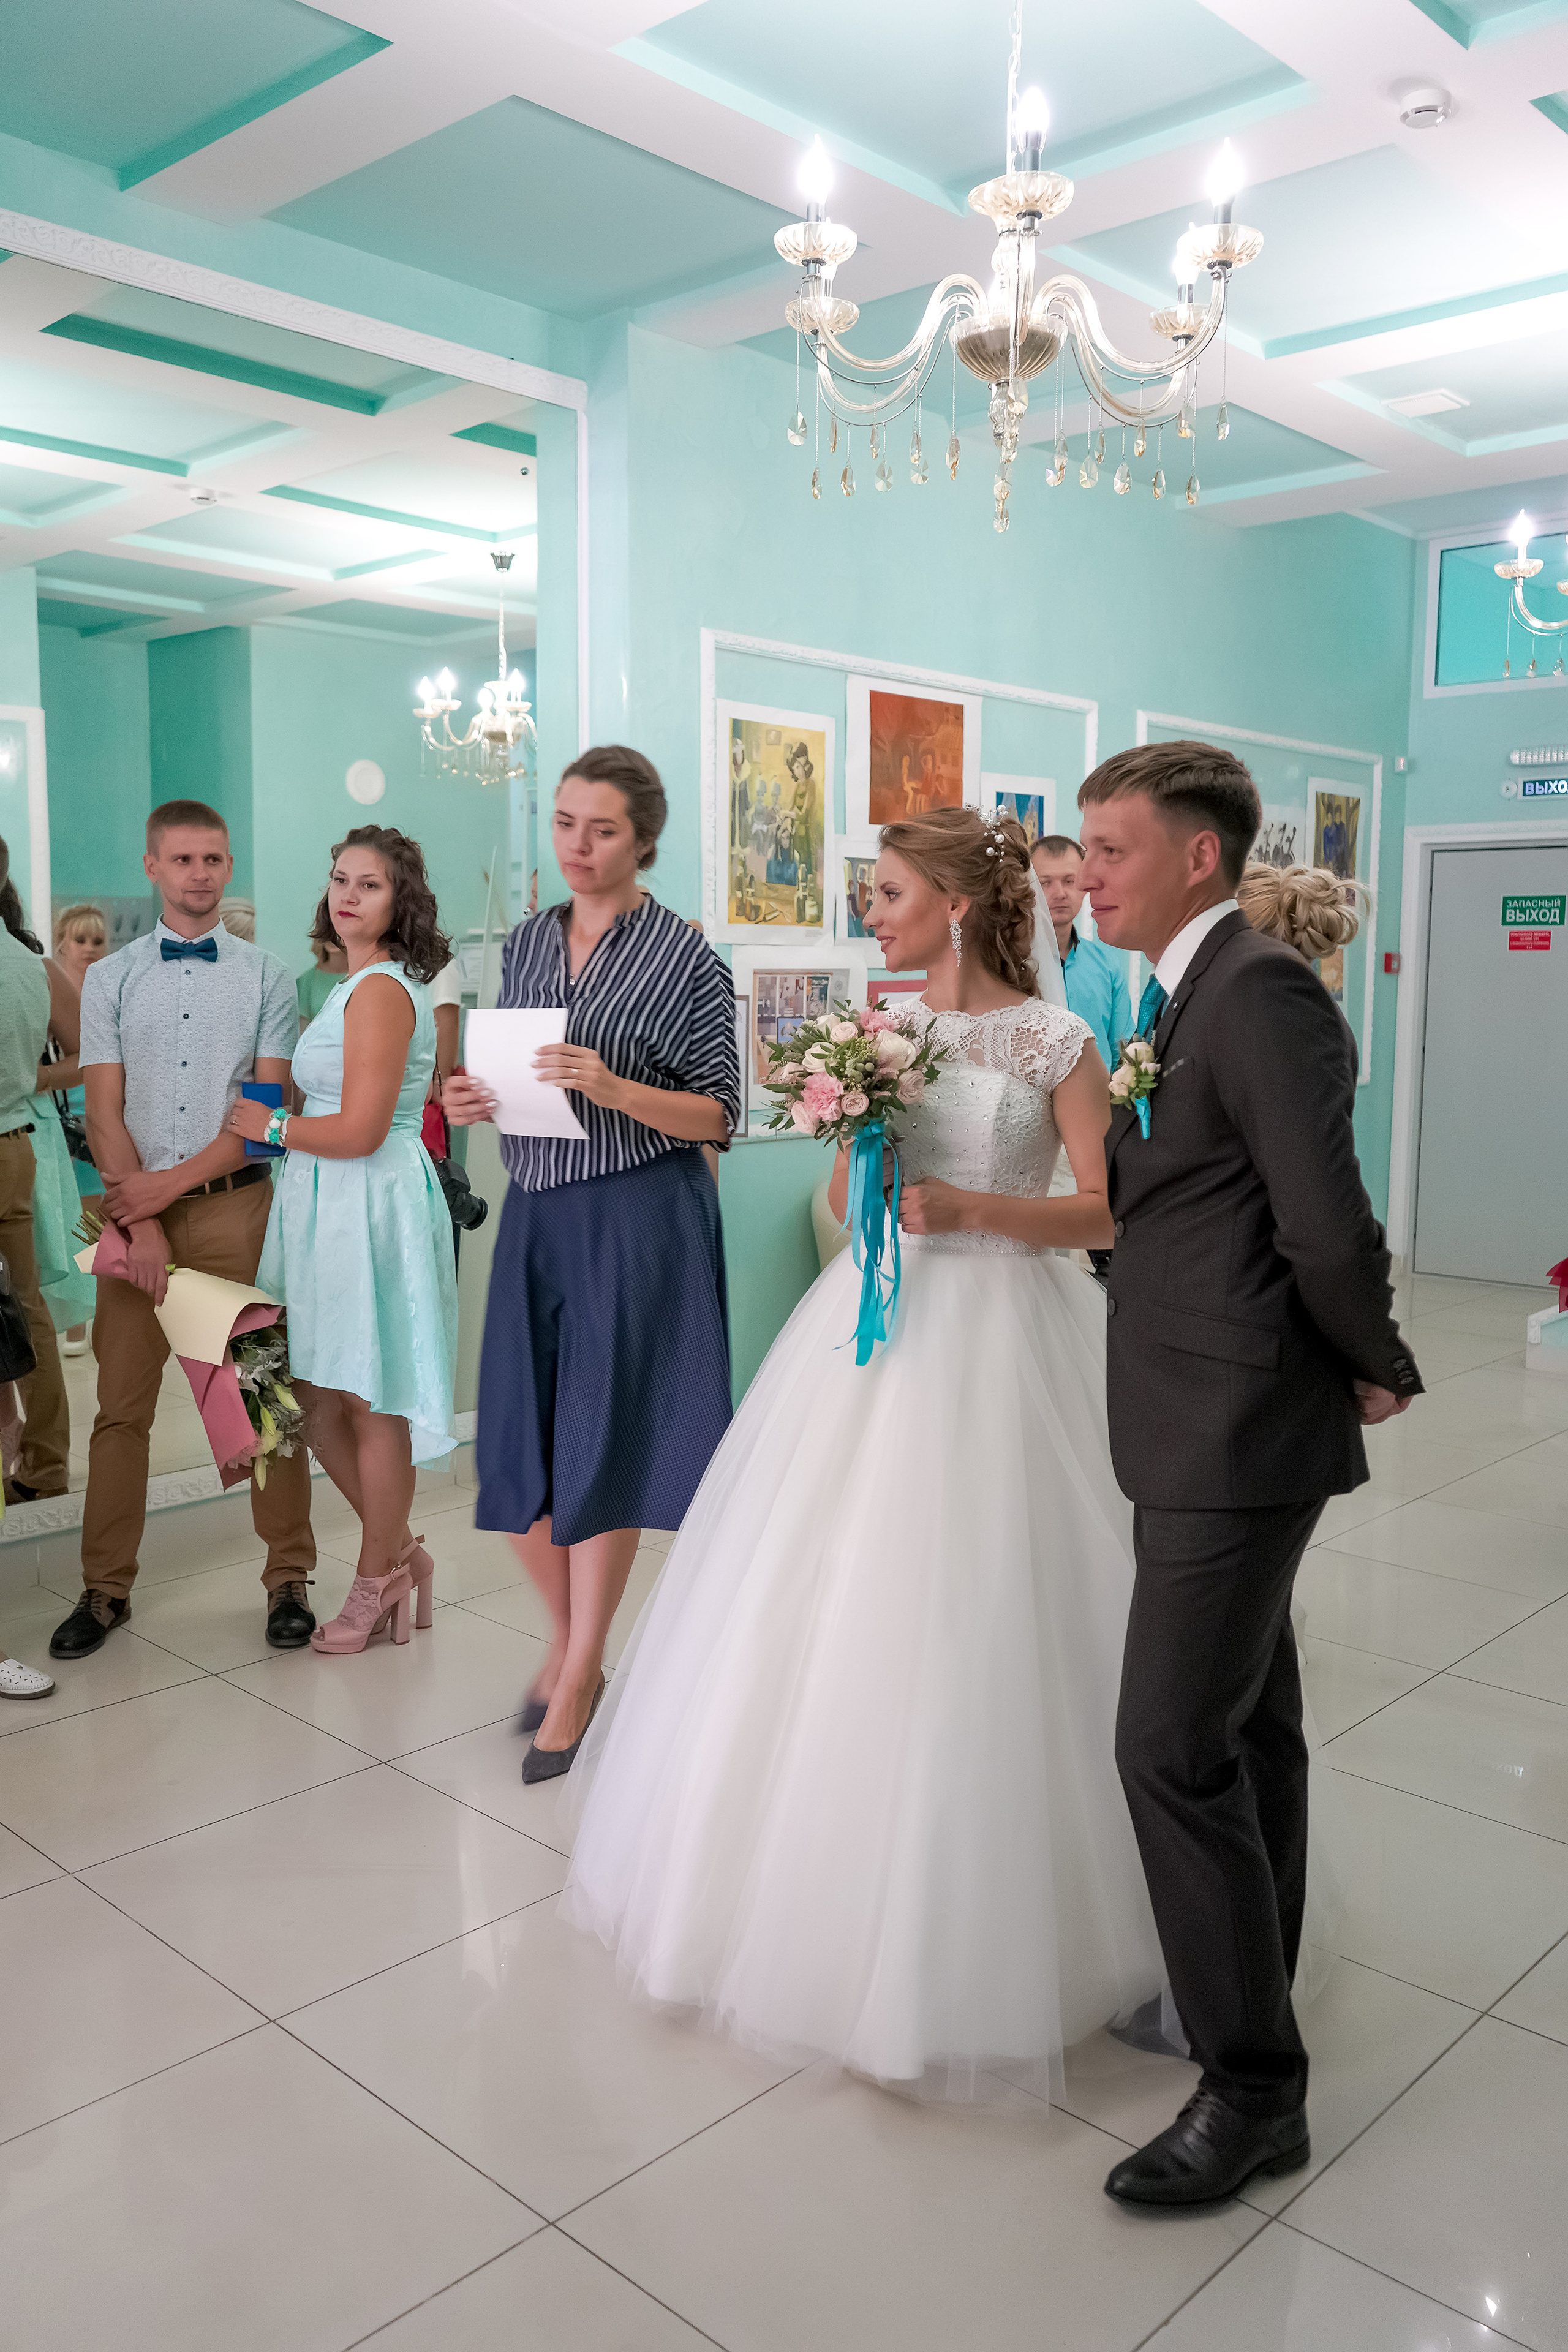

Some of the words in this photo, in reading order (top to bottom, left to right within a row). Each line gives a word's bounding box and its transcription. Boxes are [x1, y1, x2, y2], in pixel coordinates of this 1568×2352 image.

[1525, 780, 1568, 795] ВЫХО
[1506, 897, 1561, 908] ЗАПАСНЫЙ
[1506, 909, 1560, 924] ВЫХОД
